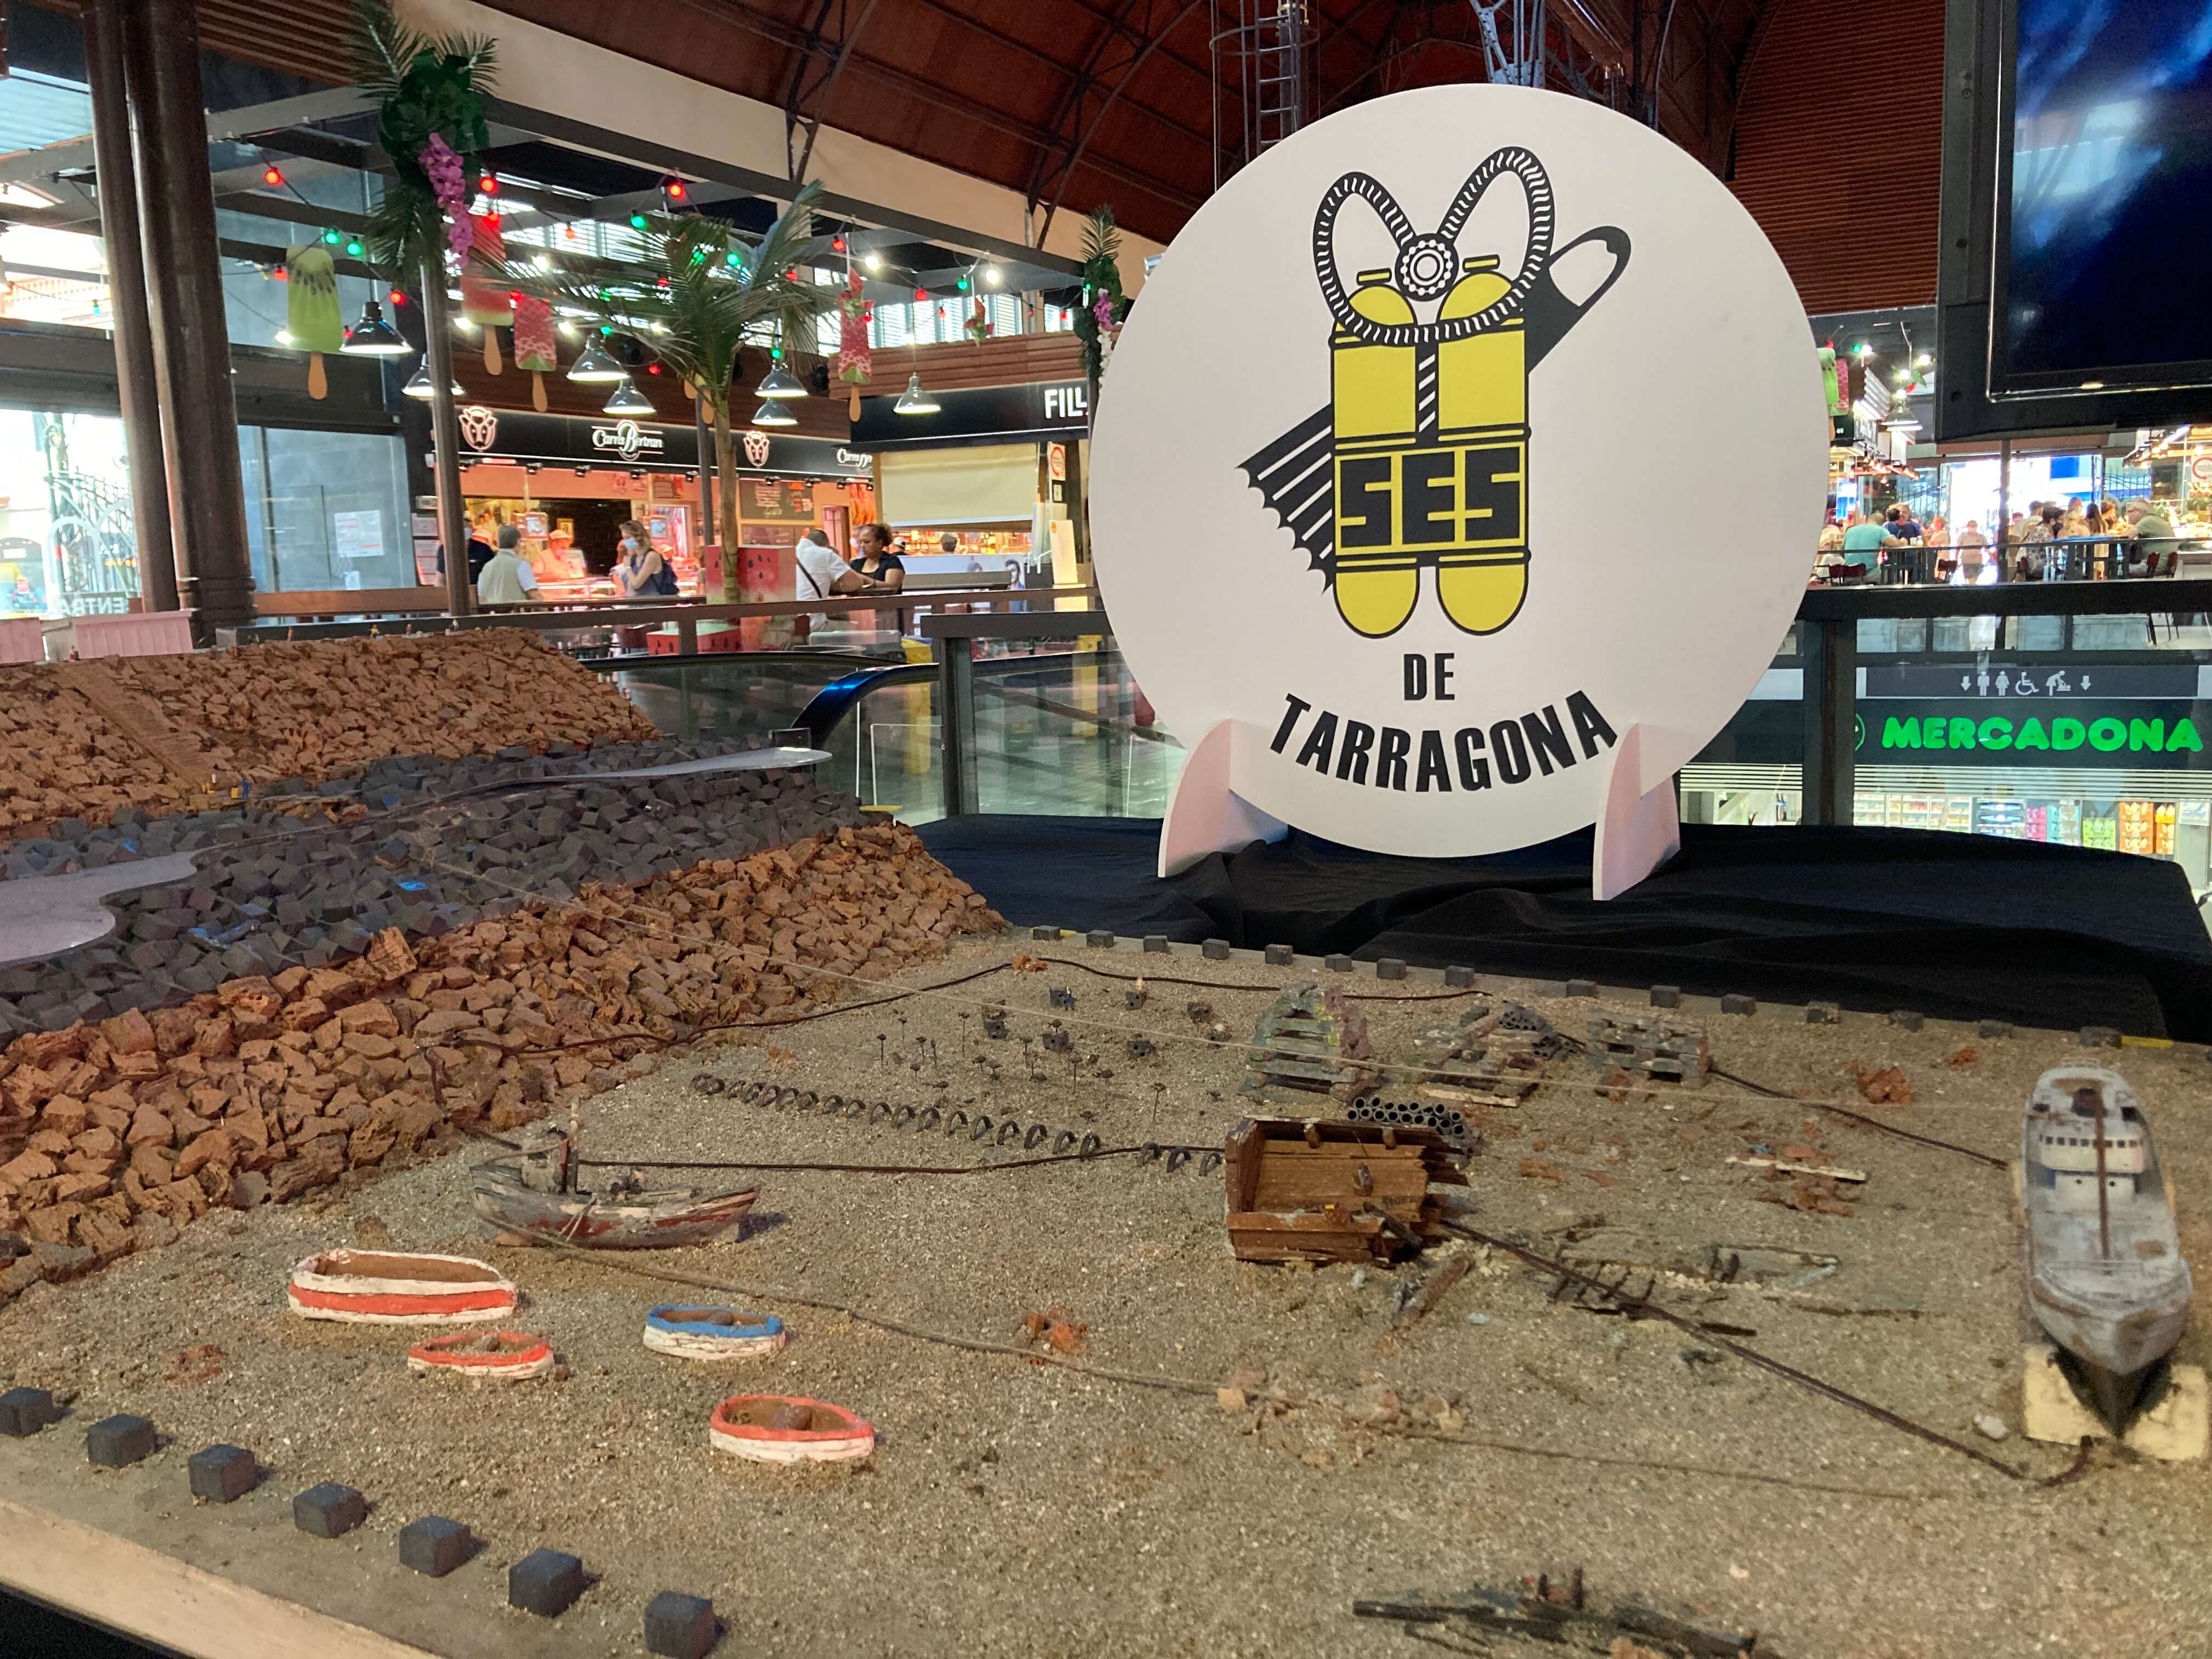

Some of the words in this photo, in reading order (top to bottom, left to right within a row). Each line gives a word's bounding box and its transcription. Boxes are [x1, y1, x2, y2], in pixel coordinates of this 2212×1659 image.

[1045, 387, 1088, 419] FILL
[1340, 446, 1520, 548] SES
[1403, 653, 1455, 701] DE
[1270, 690, 1617, 792] TARRAGONA
[1882, 717, 2203, 752] MERCADONA
